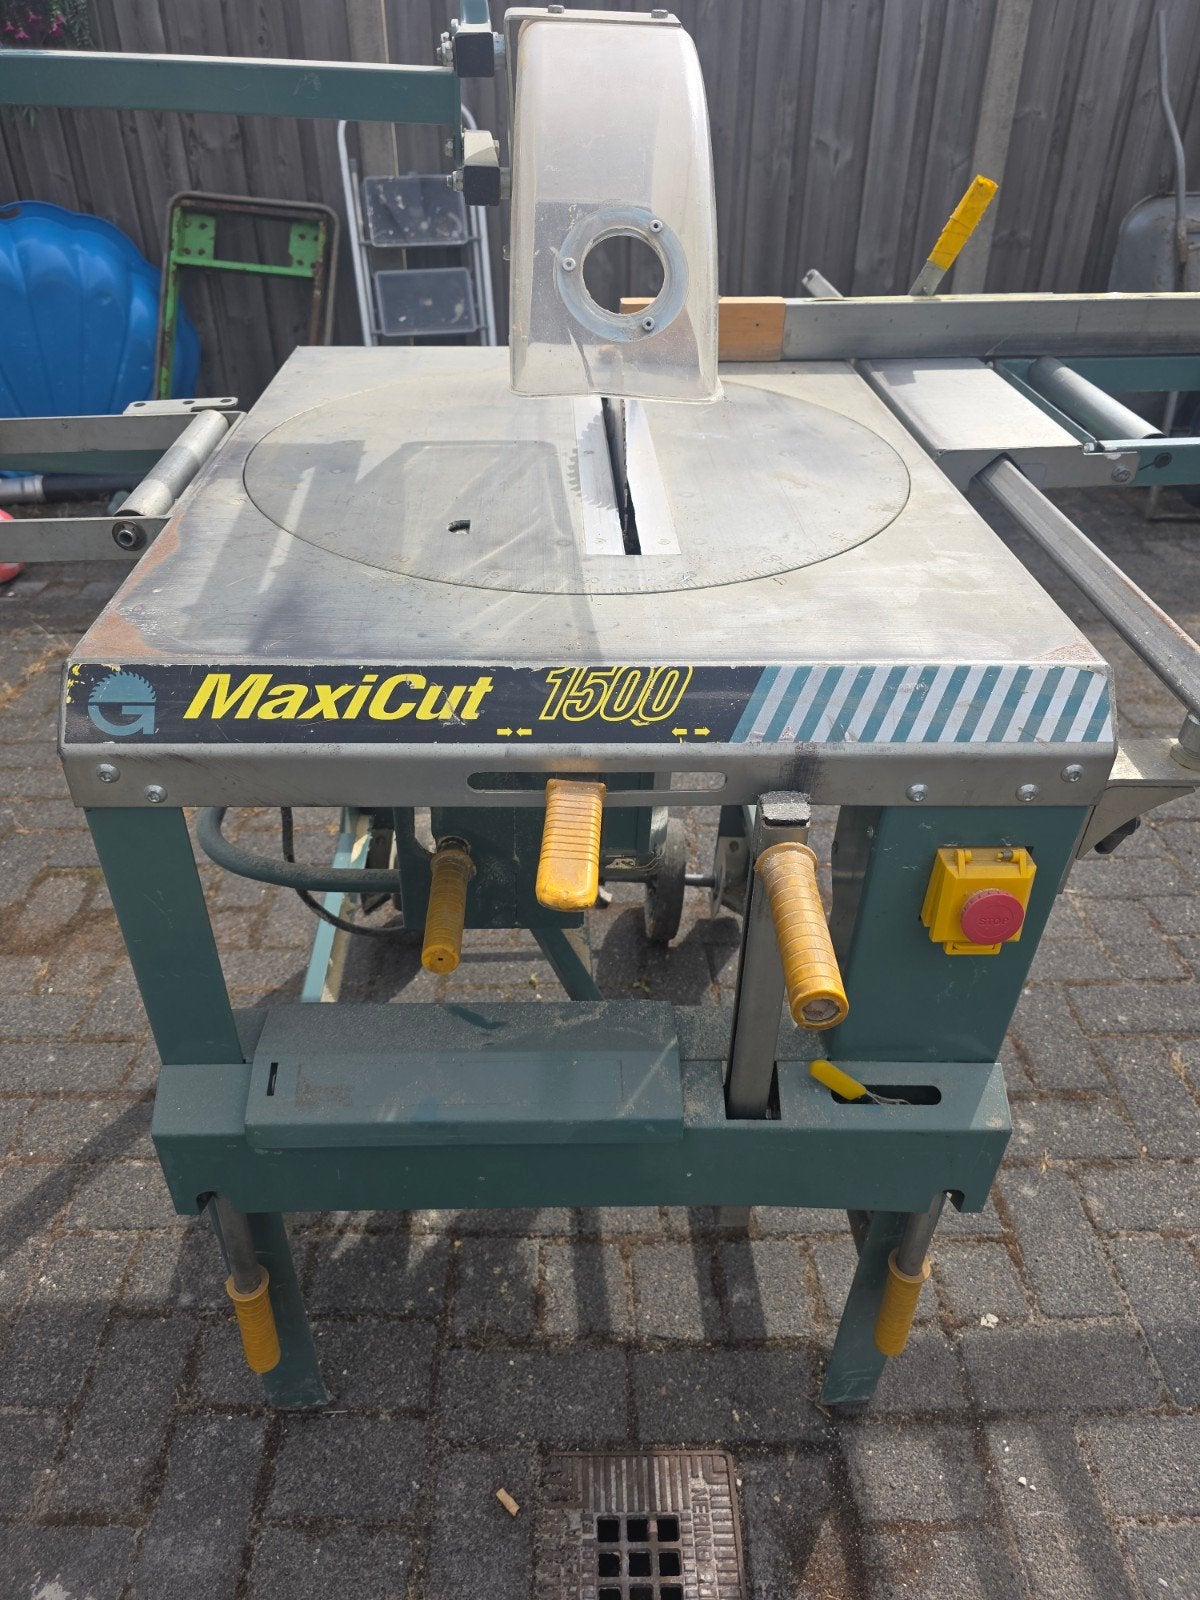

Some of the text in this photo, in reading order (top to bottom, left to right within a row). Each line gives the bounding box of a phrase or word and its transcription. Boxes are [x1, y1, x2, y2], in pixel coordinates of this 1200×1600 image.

[183, 666, 694, 722] MaxiCut 1500
[977, 916, 1009, 926] STOP
